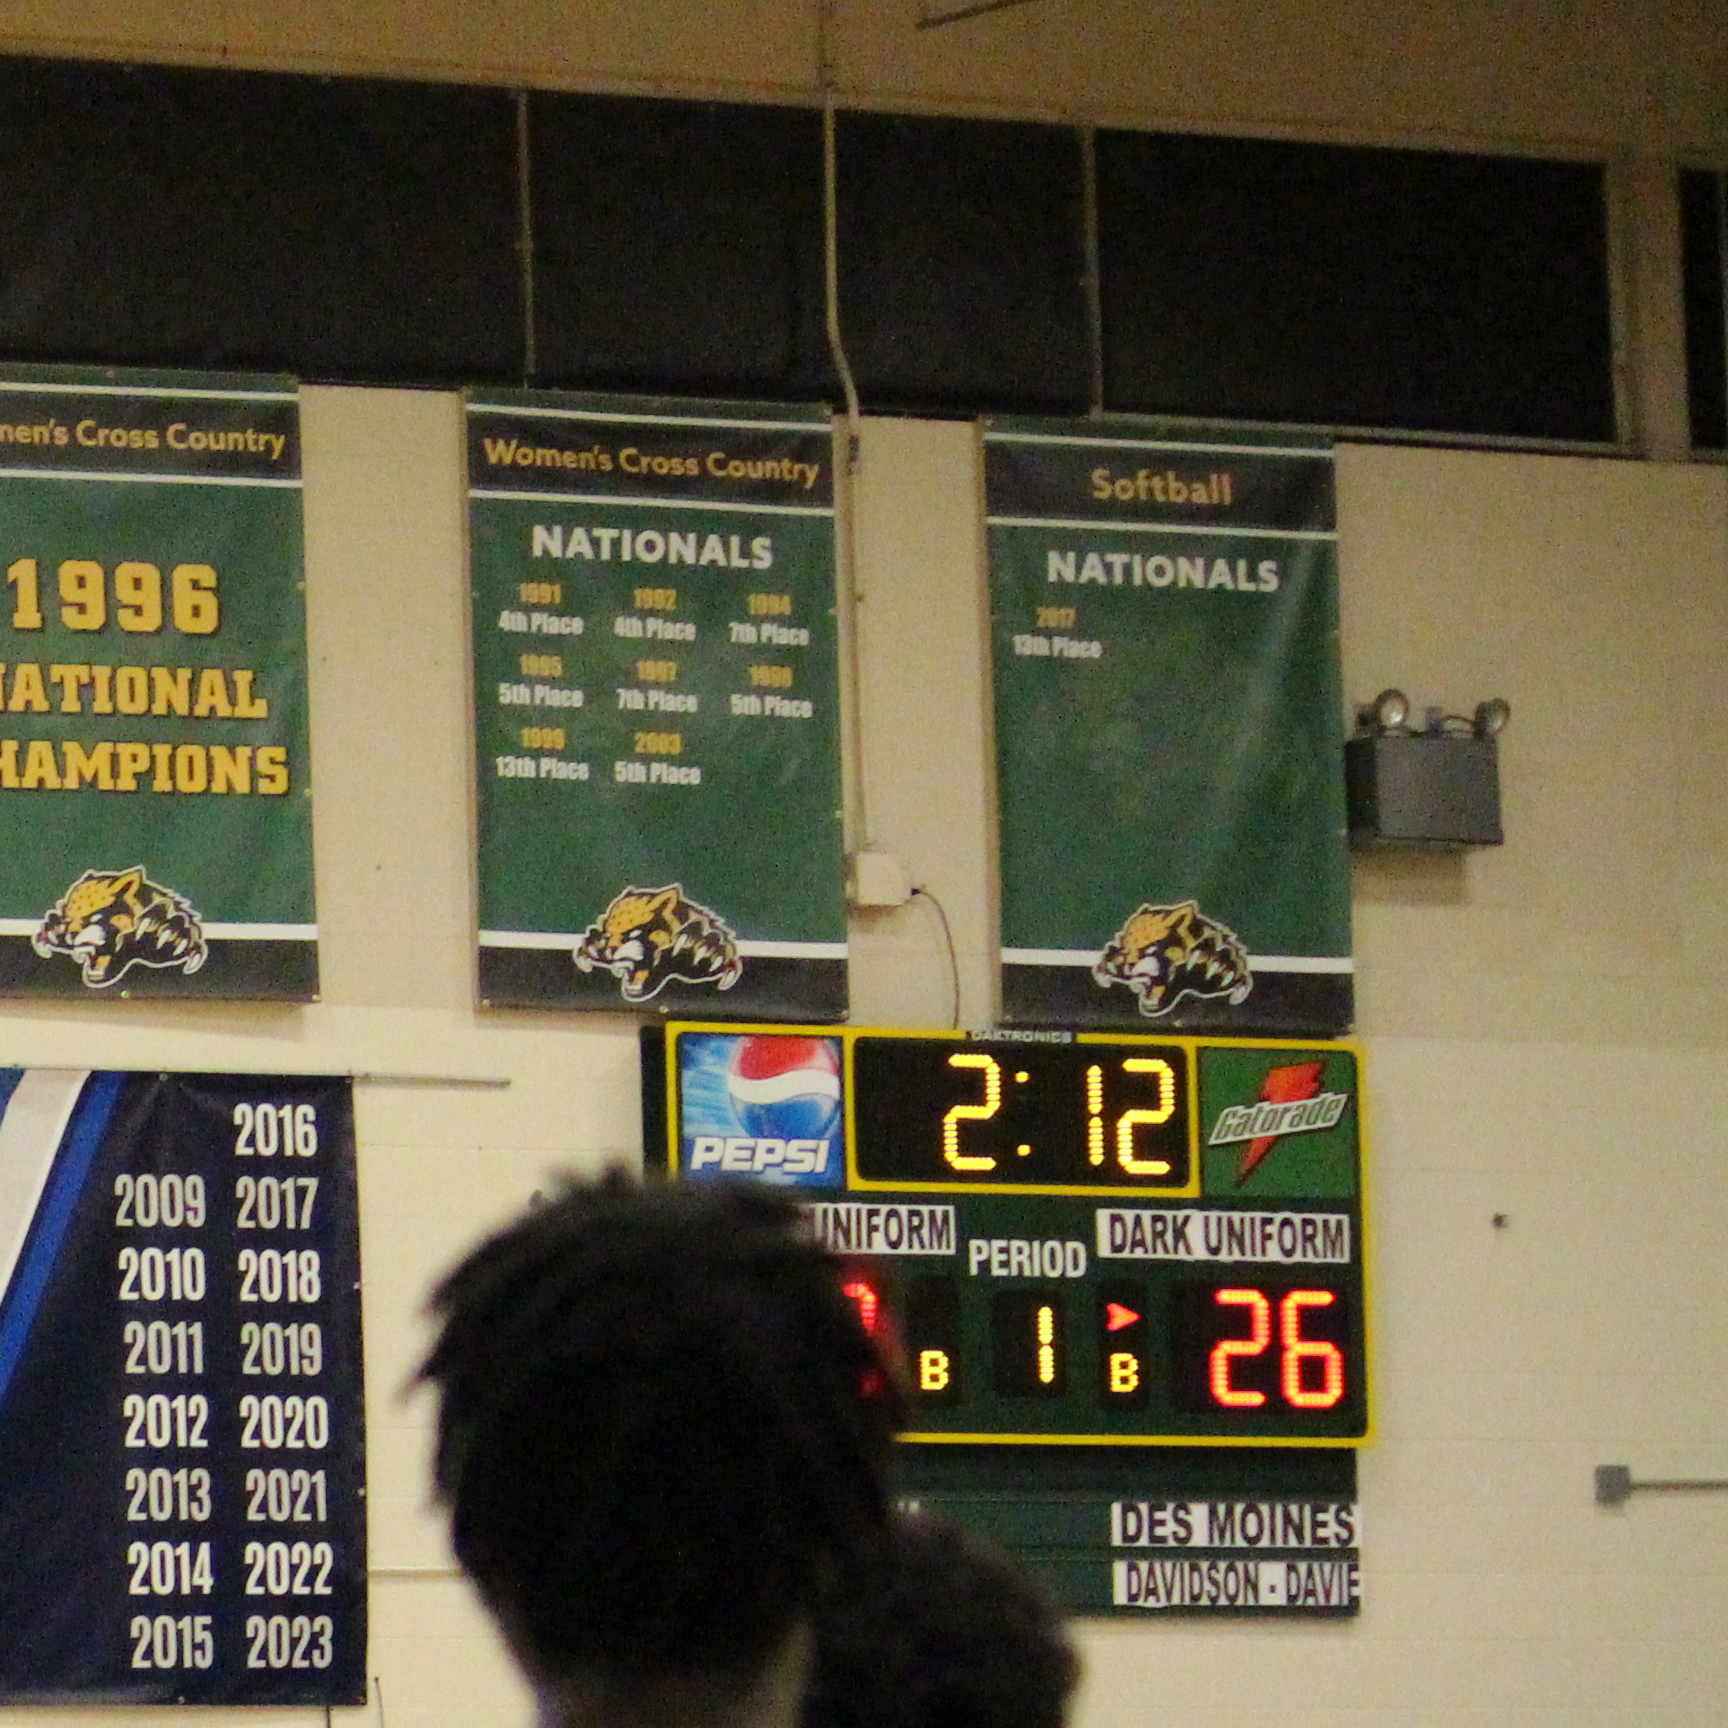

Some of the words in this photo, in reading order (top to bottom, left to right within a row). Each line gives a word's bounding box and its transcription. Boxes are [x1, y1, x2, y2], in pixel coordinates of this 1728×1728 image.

[75, 419, 159, 448] Cross
[166, 423, 285, 459] Country
[483, 438, 612, 471] Women's
[620, 448, 699, 476] Cross
[706, 452, 819, 488] Country
[1092, 468, 1233, 505] Softball
[532, 525, 773, 569] NATIONALS
[1047, 551, 1279, 593] NATIONALS
[7, 558, 219, 634] 1996
[530, 612, 584, 635] Place
[534, 684, 584, 708] Place
[540, 757, 589, 780] Place
[972, 1030, 1071, 1043] DAKTRONICS
[234, 1104, 318, 1157] 2016
[943, 1054, 1174, 1175] 2:12
[1214, 1095, 1344, 1141] Gatorade
[691, 1136, 830, 1173] PEPSI
[114, 1174, 206, 1228] 2009
[236, 1176, 318, 1230] 2017
[969, 1238, 1087, 1278] PERIOD
[1110, 1214, 1193, 1254] DARK
[1204, 1216, 1345, 1260] UNIFORM
[118, 1247, 206, 1300] 2010
[238, 1250, 321, 1303] 2018
[124, 1321, 204, 1374] 2011
[240, 1322, 322, 1376] 2019
[920, 1350, 949, 1391] B
[1038, 1306, 1054, 1384] 1
[1210, 1289, 1344, 1407] 26
[1111, 1353, 1139, 1393] B
[123, 1394, 208, 1448] 2012
[240, 1396, 328, 1449] 2020
[126, 1468, 211, 1522] 2013
[246, 1469, 327, 1522] 2021
[1122, 1502, 1192, 1544] DES
[1208, 1503, 1354, 1547] MOINES
[128, 1541, 214, 1595] 2014
[244, 1542, 334, 1596] 2022
[1127, 1562, 1258, 1604] DAVIDSON
[130, 1615, 214, 1668] 2015
[246, 1616, 333, 1669] 2023
